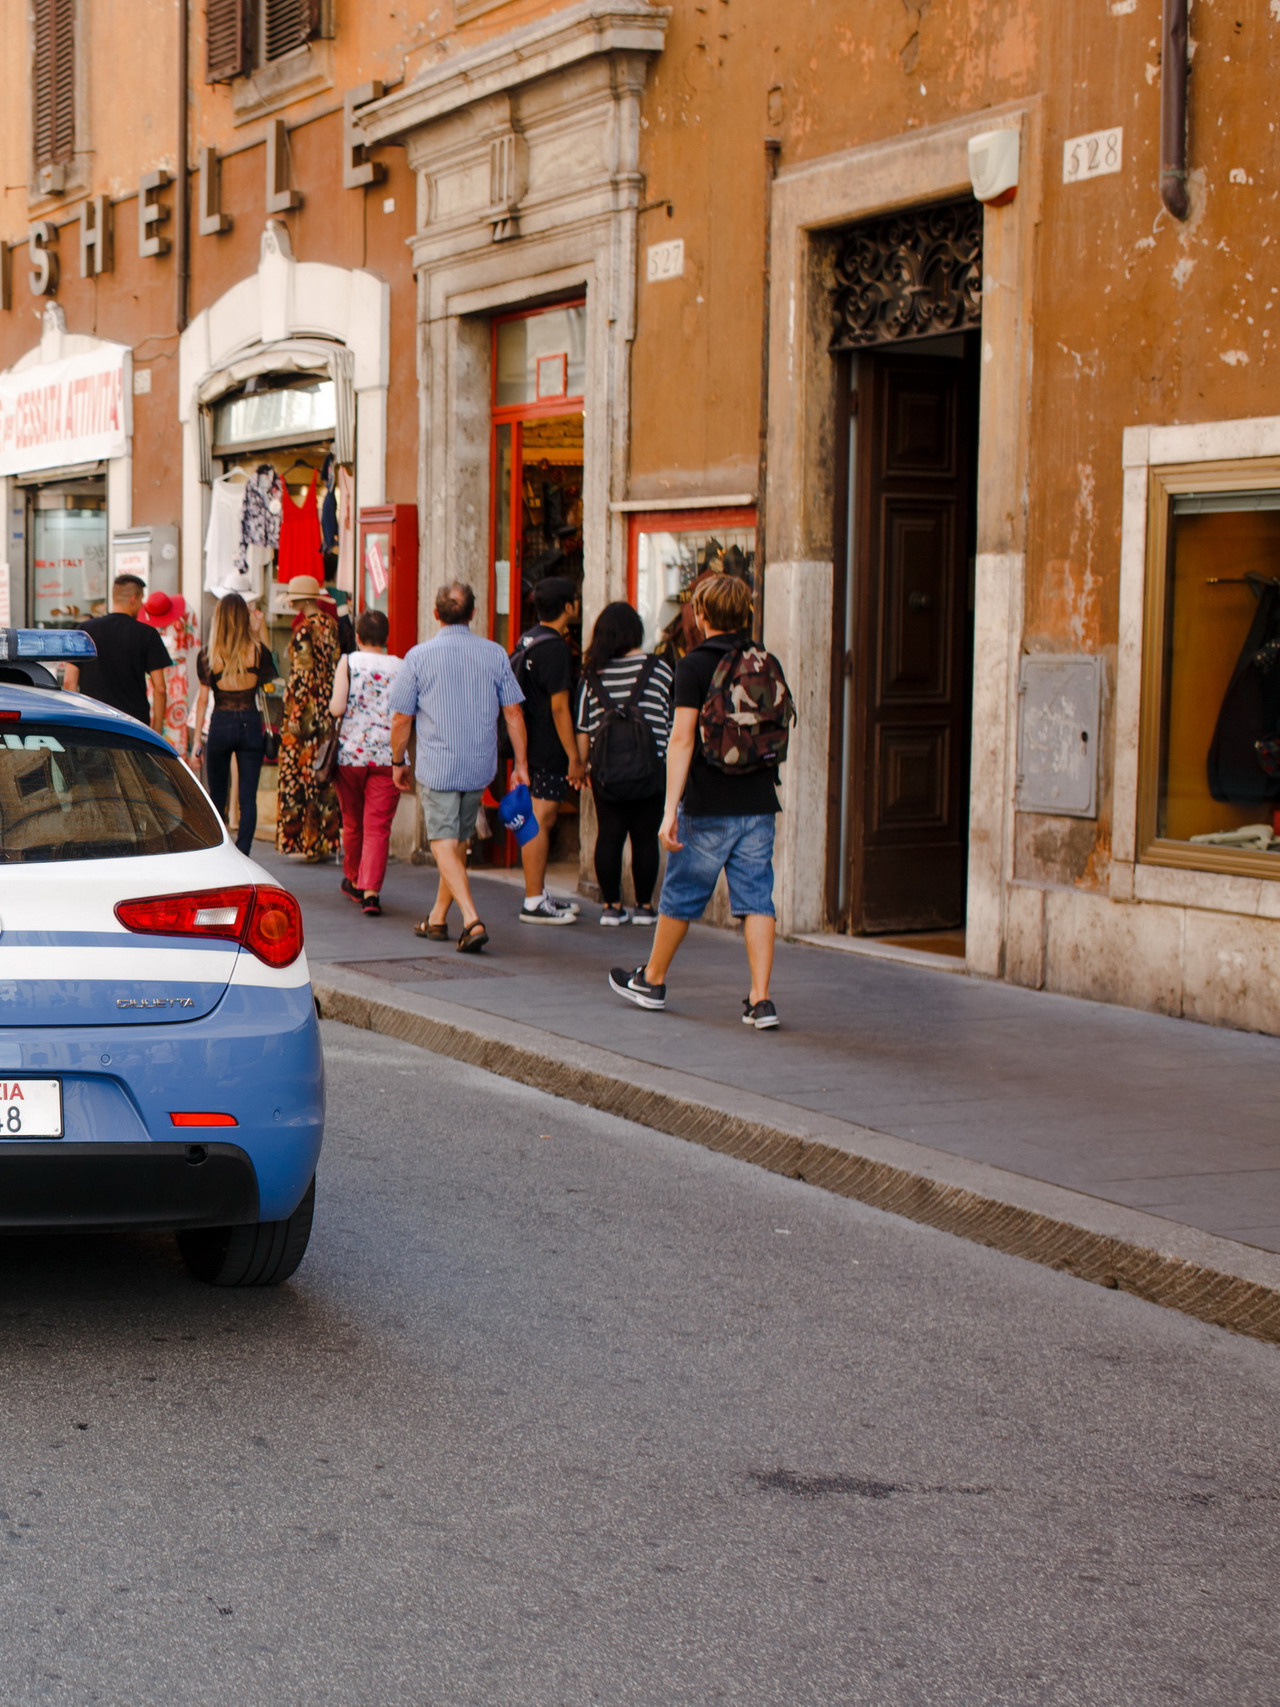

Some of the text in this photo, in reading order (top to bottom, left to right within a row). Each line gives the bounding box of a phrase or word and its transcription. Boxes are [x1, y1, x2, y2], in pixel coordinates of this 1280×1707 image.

[1067, 132, 1118, 176] 528
[649, 243, 681, 276] 527
[16, 381, 63, 450] CESSATA
[58, 559, 83, 568] ITALY
